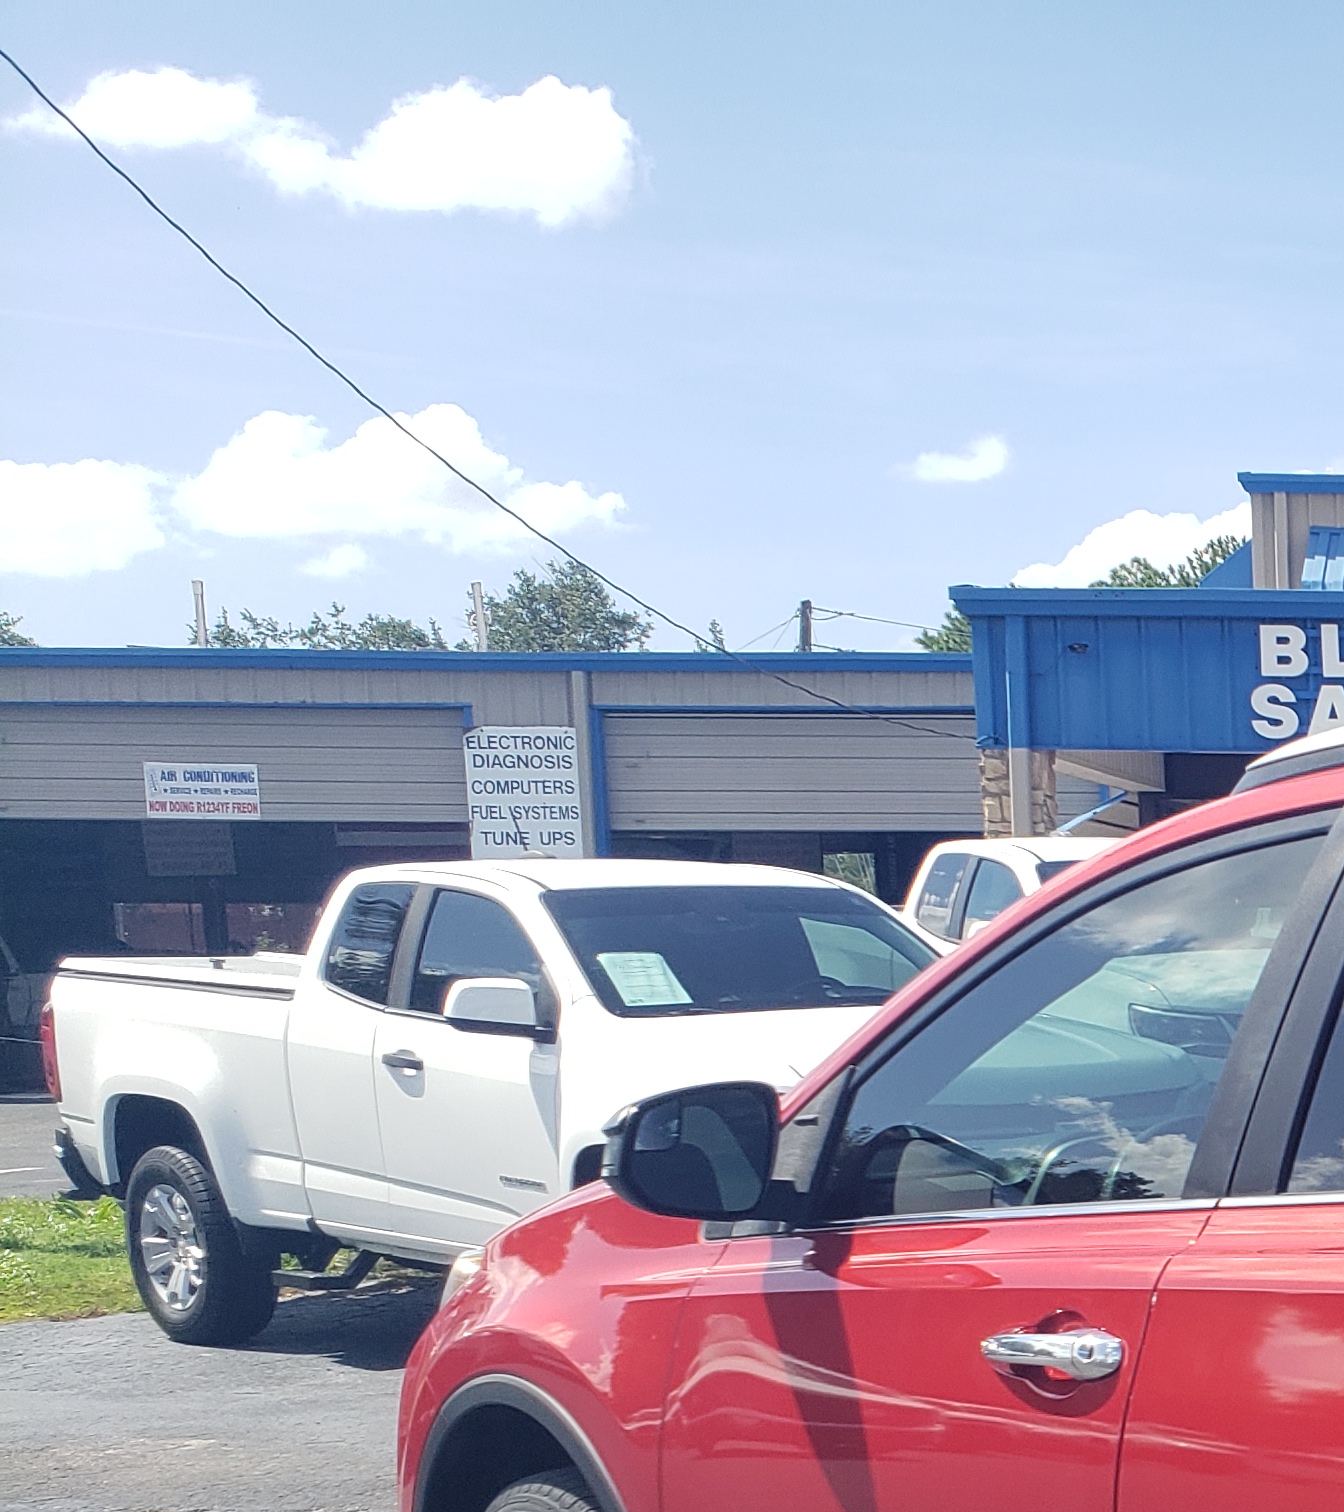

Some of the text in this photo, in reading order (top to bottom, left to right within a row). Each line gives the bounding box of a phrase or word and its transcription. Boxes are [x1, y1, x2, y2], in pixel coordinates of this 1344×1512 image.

[465, 735, 576, 751] ELECTRONIC
[472, 754, 573, 769] DIAGNOSIS
[160, 770, 255, 783] AIR CONDITIONING
[471, 780, 575, 795] COMPUTERS
[149, 801, 258, 814] NOW DOING R1234YF FREON
[471, 805, 579, 820] FUEL SYSTEMS
[480, 831, 576, 846] TUNE UPS
